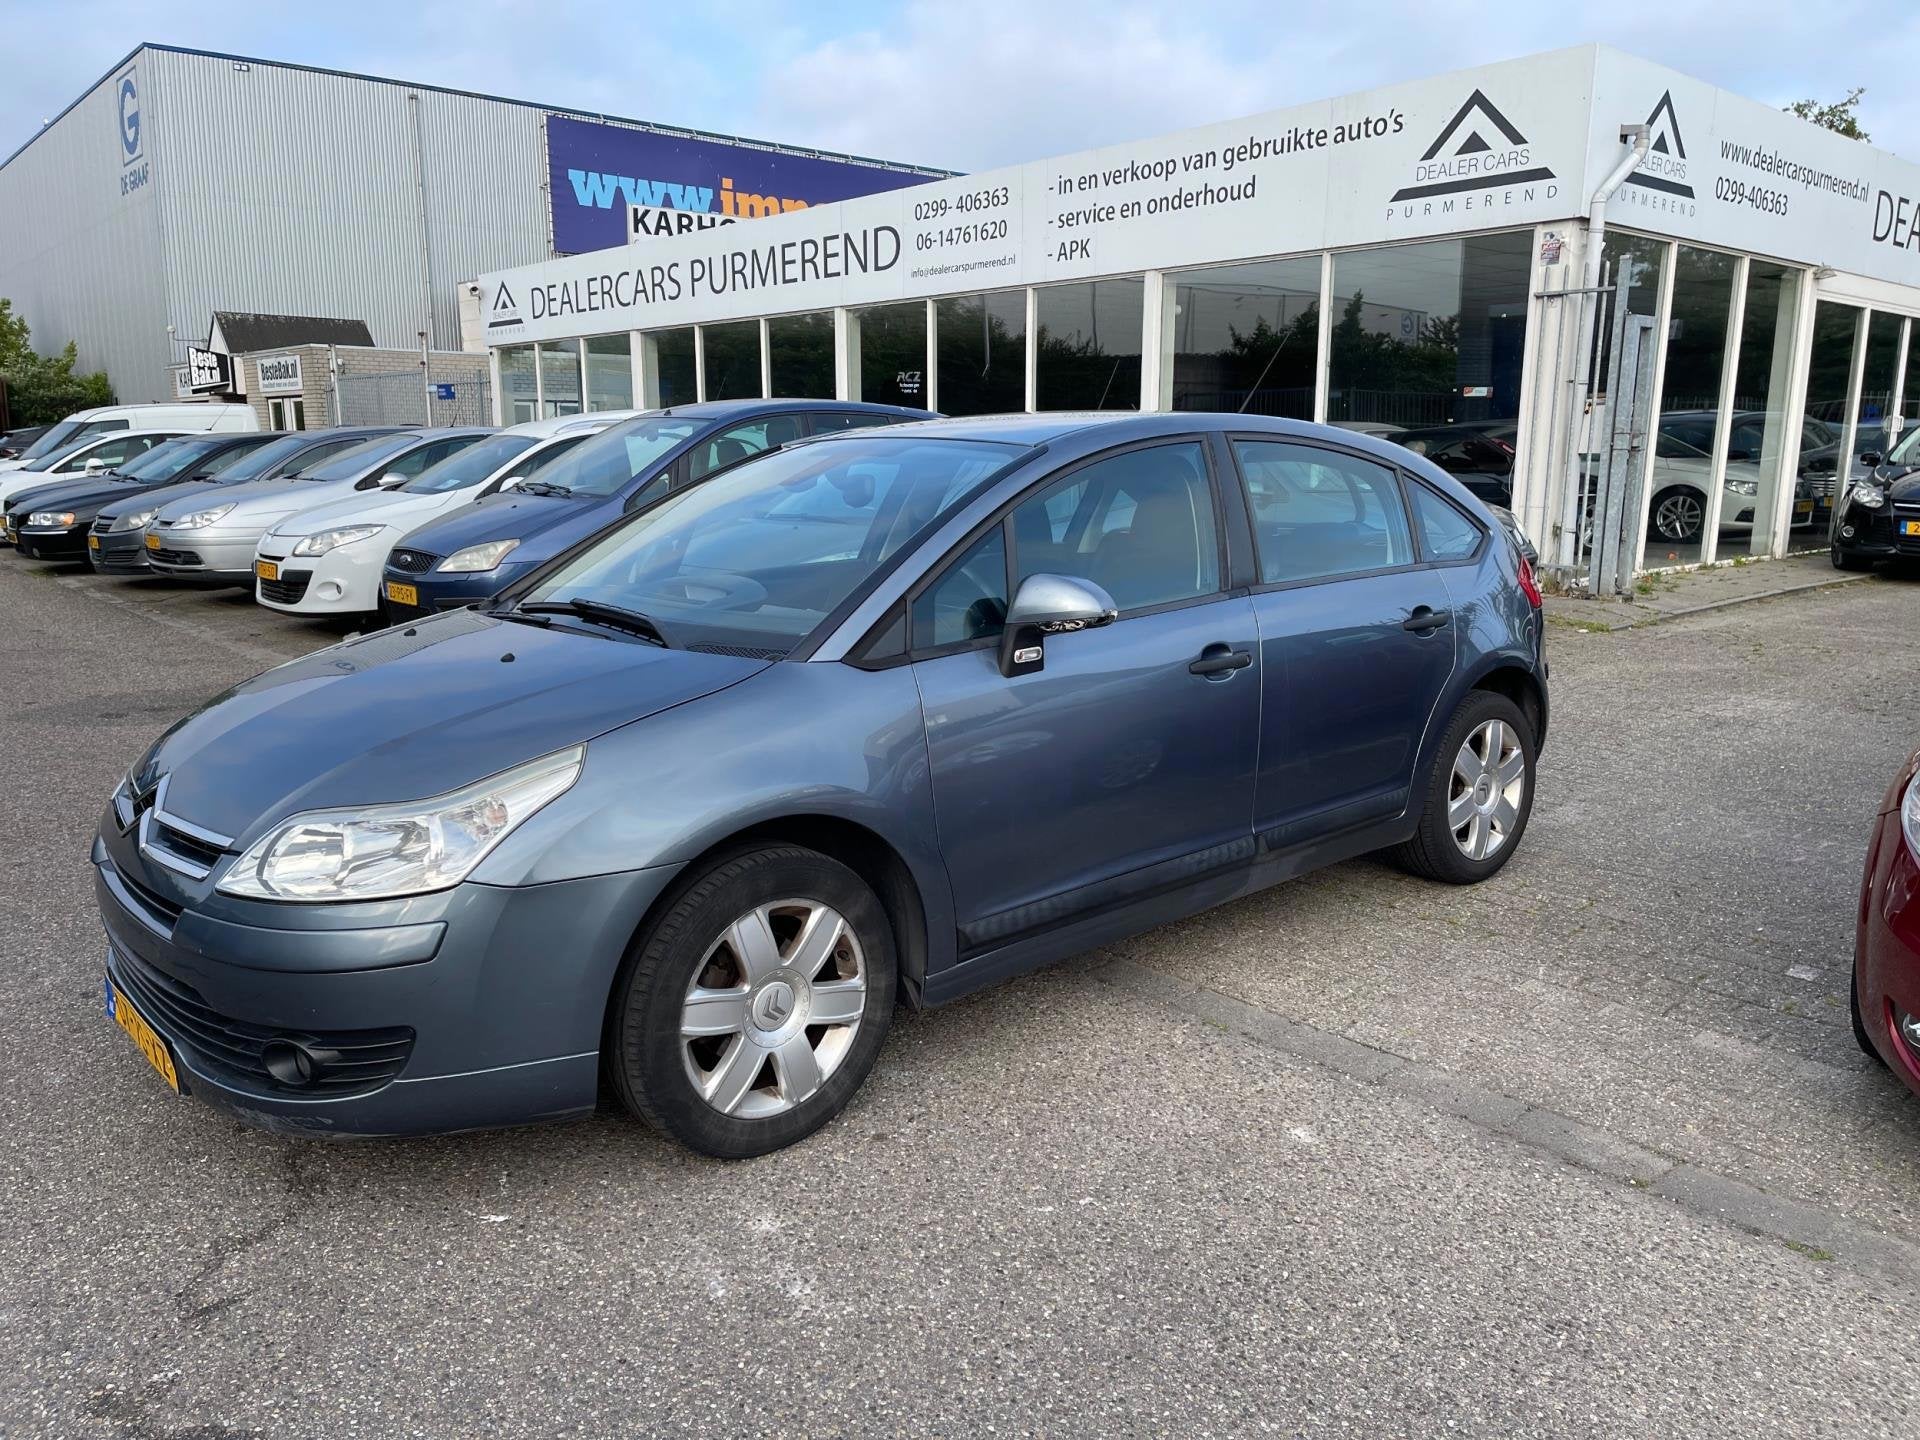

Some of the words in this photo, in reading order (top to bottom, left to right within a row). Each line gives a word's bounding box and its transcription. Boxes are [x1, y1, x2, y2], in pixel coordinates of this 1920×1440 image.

[1058, 175, 1073, 194] in
[1078, 173, 1098, 191] en
[1102, 159, 1177, 187] verkoop
[1182, 150, 1217, 172] van
[1222, 127, 1328, 170] gebruikte
[1333, 108, 1404, 145] auto's
[1416, 157, 1480, 181] DEALER
[1483, 149, 1531, 171] CARS
[1663, 159, 1687, 180] CARS
[1720, 140, 1870, 203] www.dealercarspurmerend.nl
[1058, 203, 1116, 228] service
[1120, 200, 1141, 219] en
[1146, 175, 1256, 214] onderhoud
[1386, 185, 1558, 221] PURMEREND
[1715, 176, 1789, 216] 0299-406363
[916, 219, 1008, 251] 06-14761620
[1057, 239, 1091, 262] APK
[530, 262, 682, 319] DEALERCARS
[689, 225, 901, 297] PURMEREND
[911, 254, 1016, 278] info@dealercarspurmerend.nl
[188, 347, 218, 368] Beste
[261, 359, 298, 381] BesteBak.nl
[191, 367, 221, 386] Bak.nl
